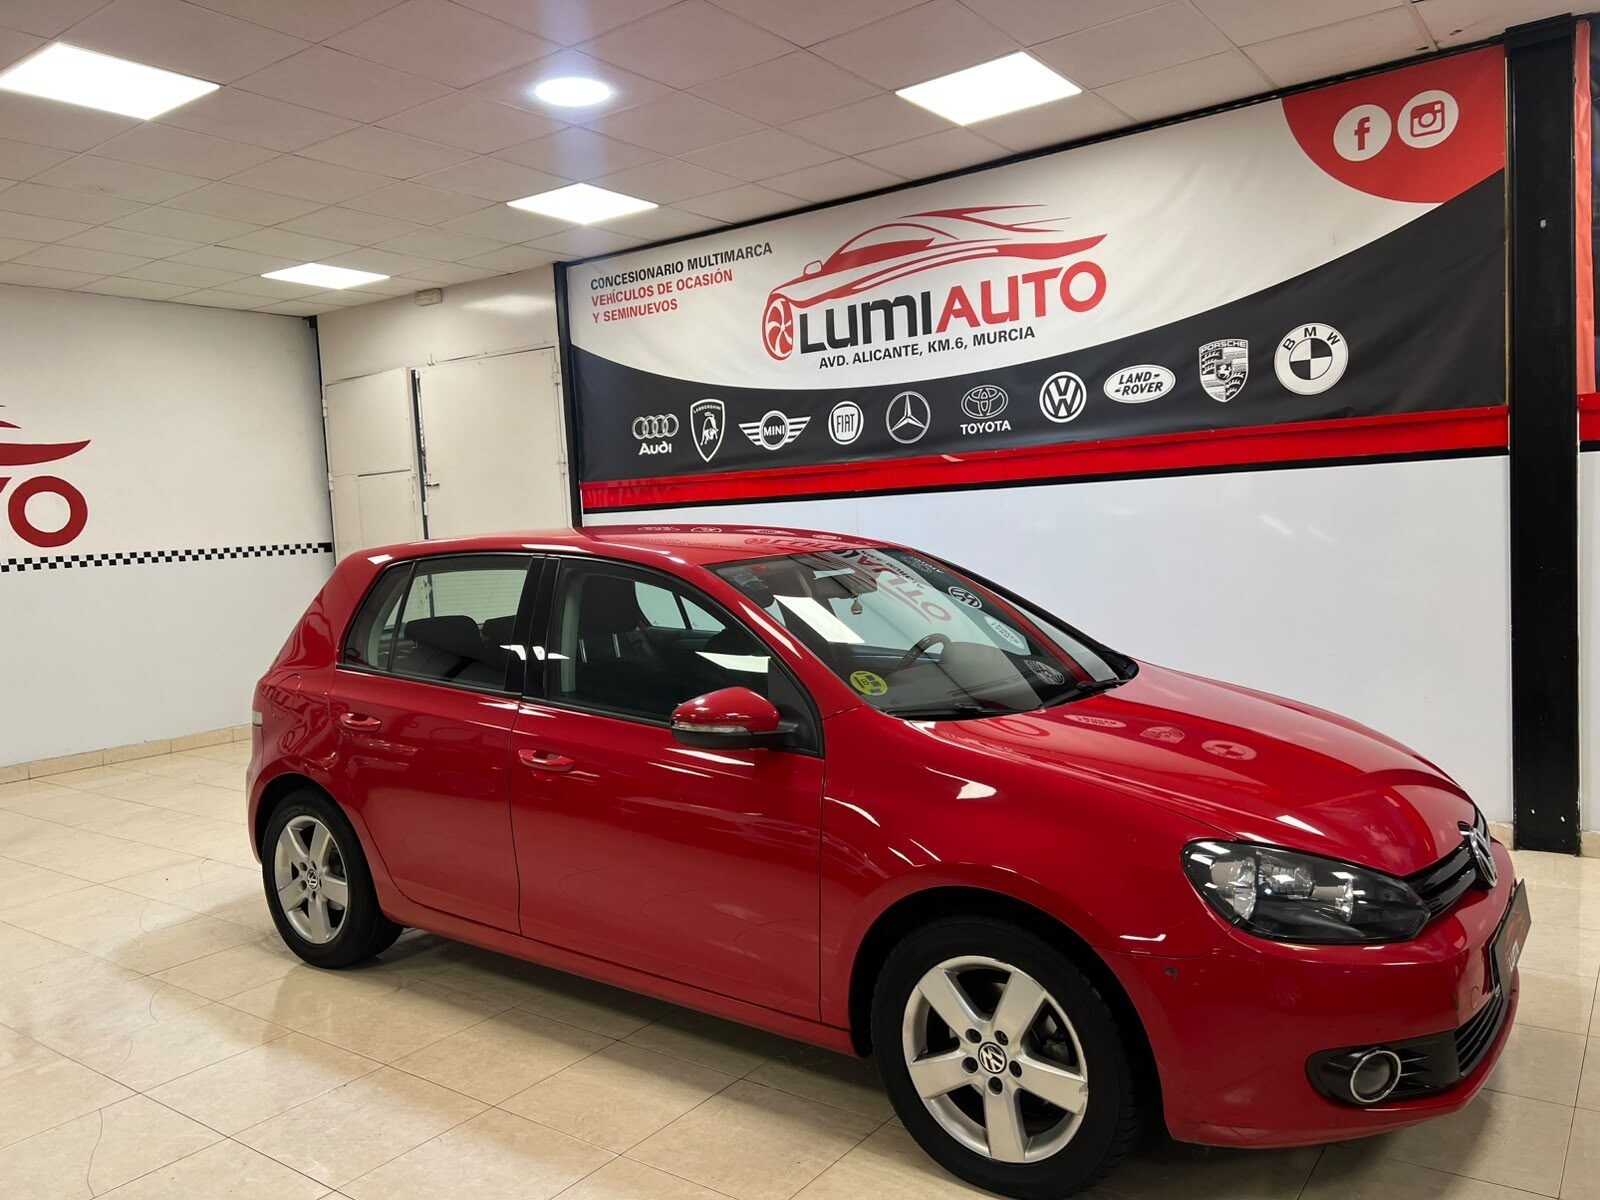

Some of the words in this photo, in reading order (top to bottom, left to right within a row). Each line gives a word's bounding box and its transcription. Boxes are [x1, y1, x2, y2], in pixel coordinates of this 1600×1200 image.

[590, 261, 684, 291] CONCESIONARIO
[687, 242, 773, 272] MULTIMARCA
[591, 284, 654, 307] VEHÍCULOS
[657, 280, 673, 295] DE
[676, 268, 733, 292] OCASIÓN
[592, 312, 600, 324] Y
[603, 298, 678, 322] SEMINUEVOS
[818, 355, 849, 370] AVD.
[852, 344, 924, 365] ALICANTE,
[927, 336, 969, 354] KM.6,
[972, 326, 1036, 347] MURCIA
[1282, 326, 1341, 352] BMW
[763, 423, 785, 437] MINI
[836, 412, 856, 434] FIAT
[960, 419, 1012, 435] TOYOTA
[638, 441, 672, 456] Audi
